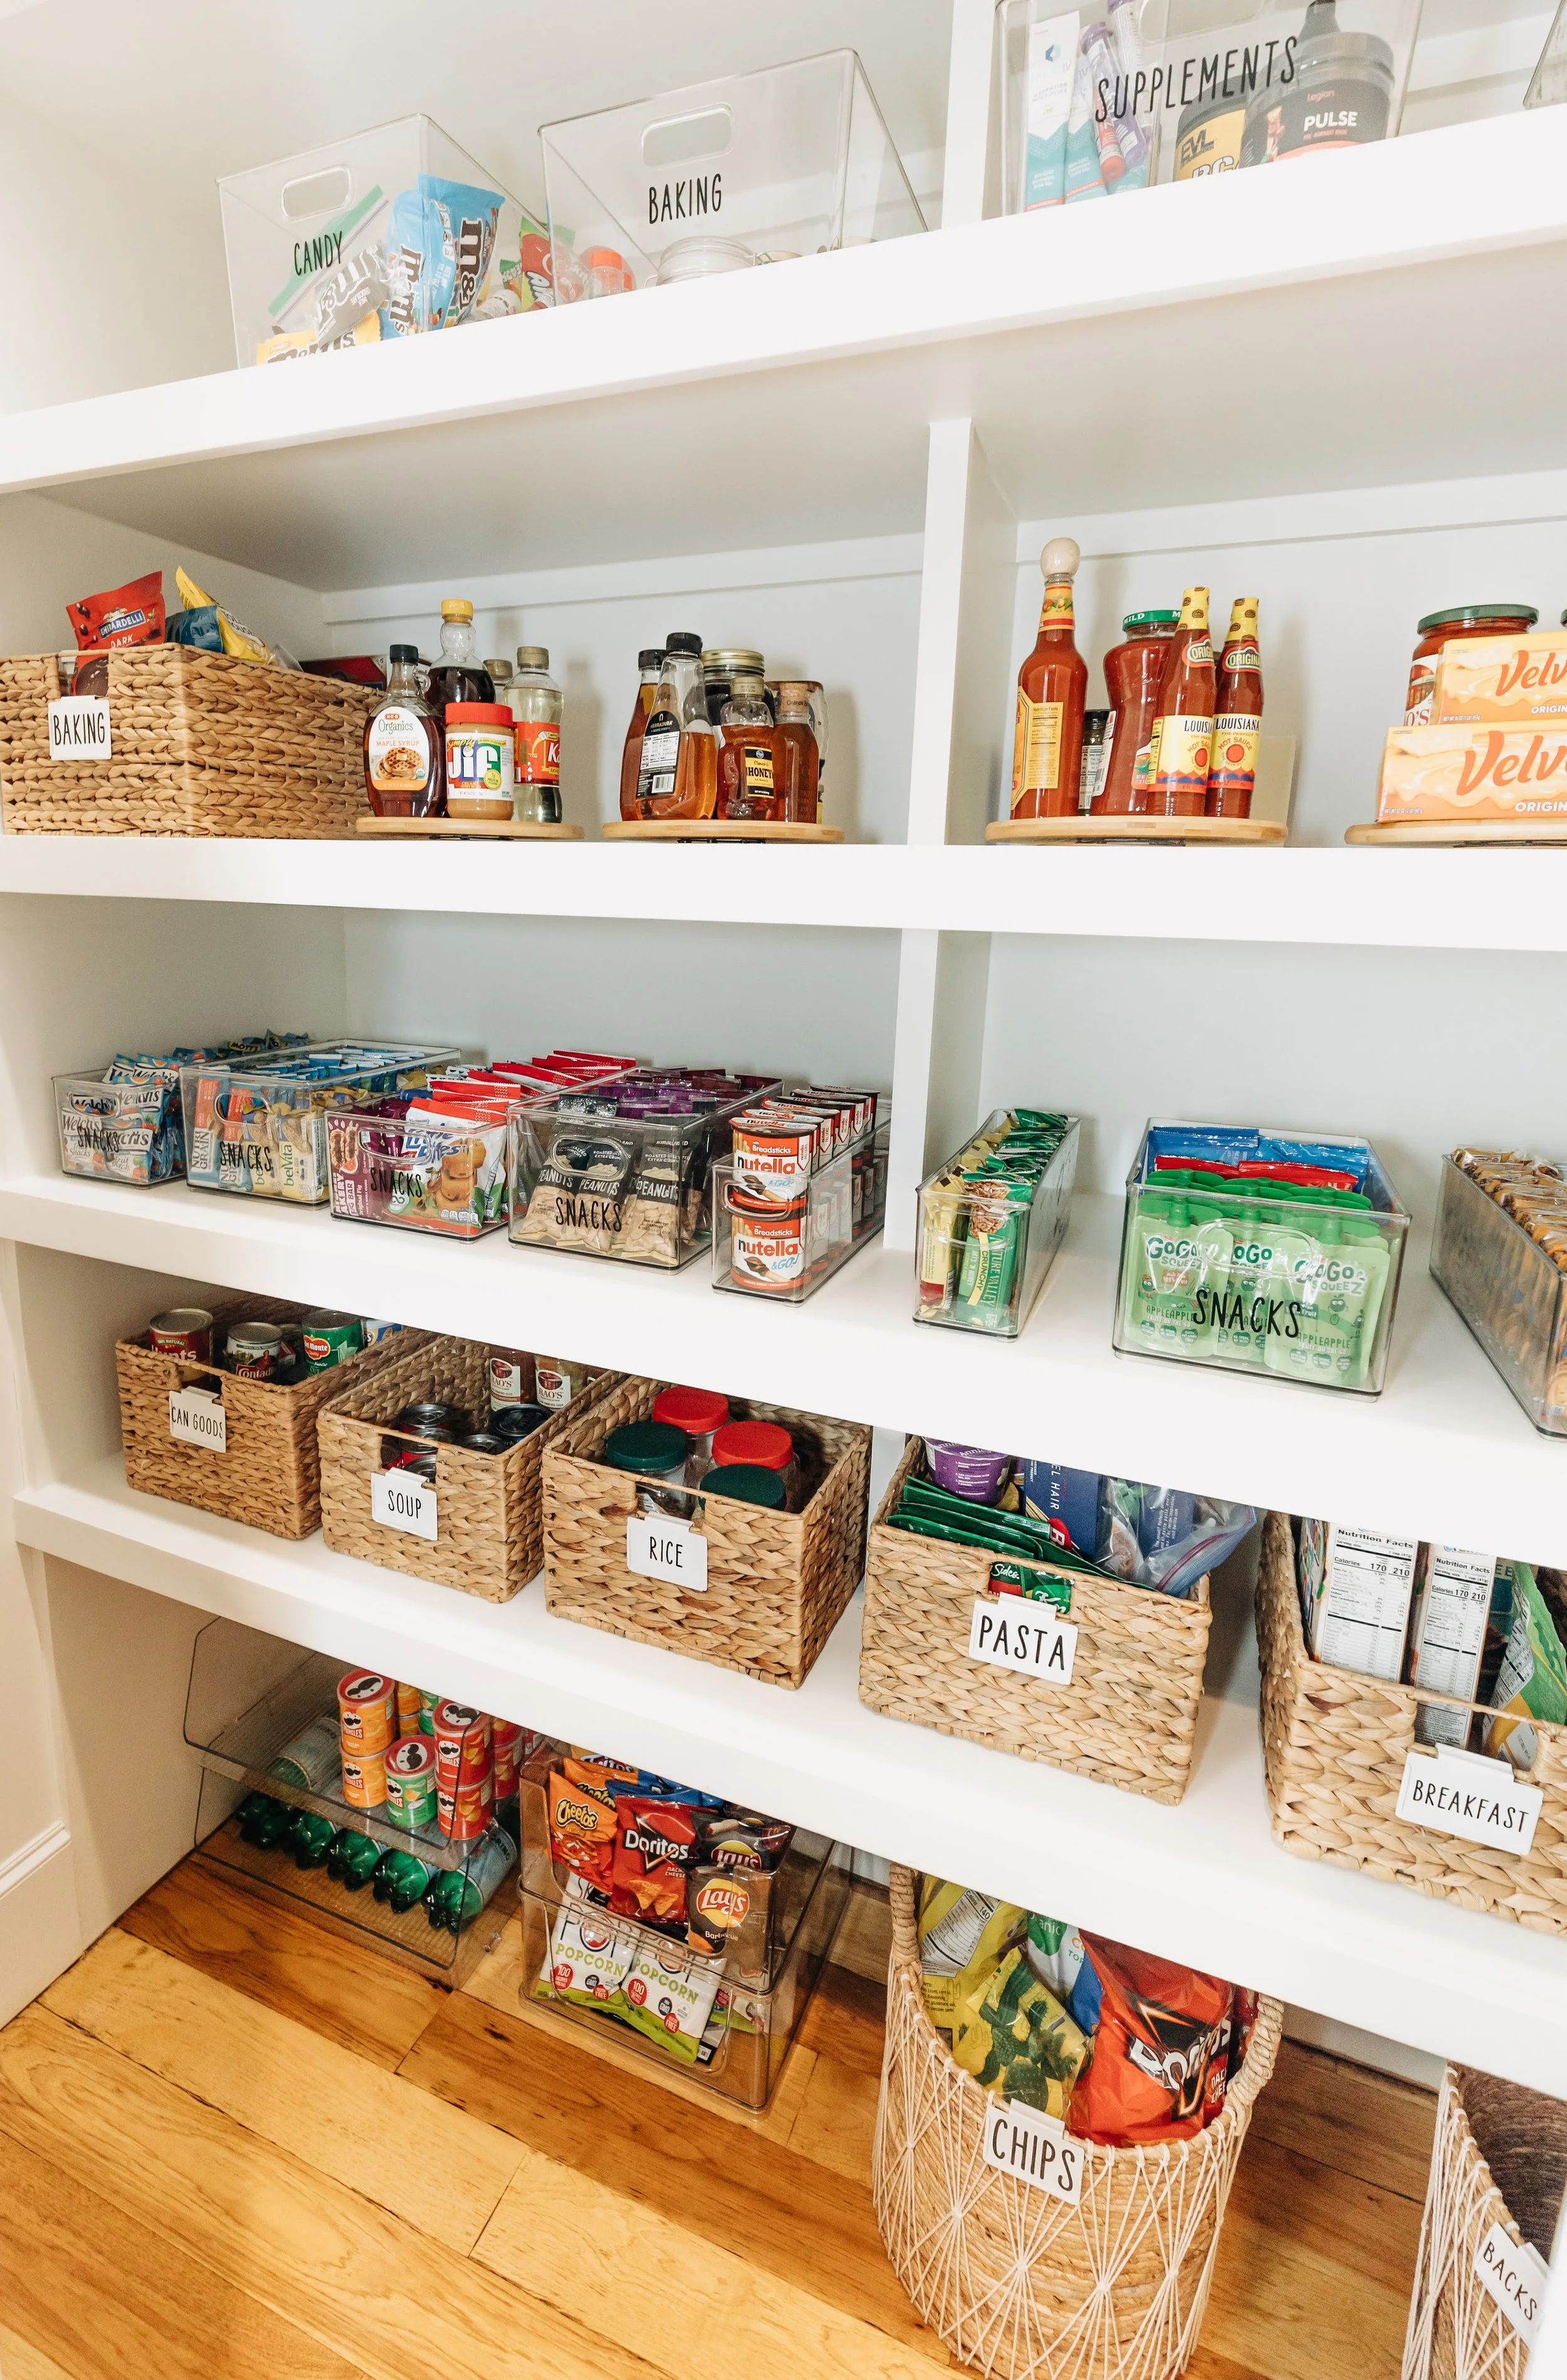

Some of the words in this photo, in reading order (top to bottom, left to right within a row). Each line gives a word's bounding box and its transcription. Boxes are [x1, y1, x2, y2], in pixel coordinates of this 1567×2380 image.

[1094, 35, 1298, 122] SUPPLEMENTS
[1307, 90, 1334, 103] legion
[1303, 111, 1358, 132] PULSE
[648, 173, 723, 224] BAKING
[293, 231, 342, 276] CANDY
[100, 612, 144, 636] GHIRARDELLI
[1123, 612, 1145, 625] MILD
[110, 633, 134, 649] DARK
[379, 719, 414, 734] Organics
[1215, 718, 1259, 731] LOUISIANA
[1404, 708, 1430, 726] O'S
[53, 712, 105, 746] BAKING
[447, 736, 476, 753] Simply
[1187, 741, 1200, 753] HOT
[1218, 738, 1232, 750] HOT
[1233, 736, 1254, 751] SAUCE
[448, 746, 498, 779] Jif
[1456, 730, 1567, 796] Velv
[747, 766, 773, 779] HONEY
[1514, 801, 1567, 813] ORIGIN
[63, 1115, 100, 1132] Welch's
[759, 1111, 795, 1120] nutella
[76, 1125, 120, 1153] SNACKS
[192, 1130, 201, 1169] NUTRI
[200, 1131, 211, 1170] GRAIN
[219, 1140, 271, 1172] SNACKS
[752, 1144, 792, 1154] Breadsticks
[283, 1144, 295, 1187] belVita
[737, 1156, 795, 1175] nutella
[370, 1167, 422, 1198] SNACKS
[579, 1179, 621, 1196] PEANUTS
[555, 1196, 622, 1233] SNACKS
[754, 1228, 793, 1236] Breadsticks
[738, 1239, 799, 1257] nutella
[1147, 1236, 1198, 1260] GoGo
[1233, 1244, 1273, 1263] oGo
[976, 1250, 989, 1292] CRUNCHY
[1294, 1260, 1355, 1284] GoGo
[980, 1275, 1000, 1308] VALLEY
[1146, 1305, 1195, 1322] APPLEAPPLE
[1192, 1289, 1301, 1339] SNACKS
[310, 1343, 328, 1352] Monte
[1296, 1332, 1352, 1349] APPLEAPPLE
[151, 1344, 197, 1362] nts
[238, 1367, 276, 1379] Contadi
[491, 1375, 512, 1387] RAO'S
[538, 1387, 563, 1399] RAO'S
[171, 1406, 189, 1428] CAN
[192, 1413, 223, 1440] GOODS
[387, 1490, 422, 1520] SOUP
[1050, 1481, 1061, 1510] HAIR
[1338, 1529, 1382, 1543] Nutrition
[1386, 1539, 1414, 1548] Facts
[649, 1536, 683, 1568] RICE
[991, 1563, 1019, 1579] Sides
[1334, 1556, 1361, 1567] Calories
[1370, 1563, 1387, 1572] 170
[1393, 1567, 1410, 1577] 210
[1436, 1558, 1468, 1569] Nutrition
[1470, 1565, 1491, 1574] Facts
[1432, 1585, 1454, 1595] Calories
[1455, 1589, 1469, 1597] 170
[1471, 1592, 1486, 1601] 210
[979, 1614, 1065, 1671] PASTA
[439, 1756, 460, 1768] PRINGLES
[557, 1798, 597, 1829] Cheetos
[1413, 1779, 1529, 1832] BREAKFAST
[625, 1829, 689, 1861] Doritos
[700, 1889, 748, 1916] Lay's
[979, 1906, 990, 1920] 140
[705, 1930, 739, 1942] Barbecue
[555, 1942, 626, 1977] POPCORN
[557, 1965, 570, 1977] 100
[586, 1978, 597, 1987] GMO
[632, 1980, 645, 1995] 100
[636, 1957, 700, 2005] POPCORN
[595, 1990, 607, 2000] FREE
[659, 2004, 671, 2014] GMO
[665, 2021, 678, 2032] FREE
[992, 2117, 1076, 2193] CHIPS
[1483, 2240, 1538, 2321] BACKS
